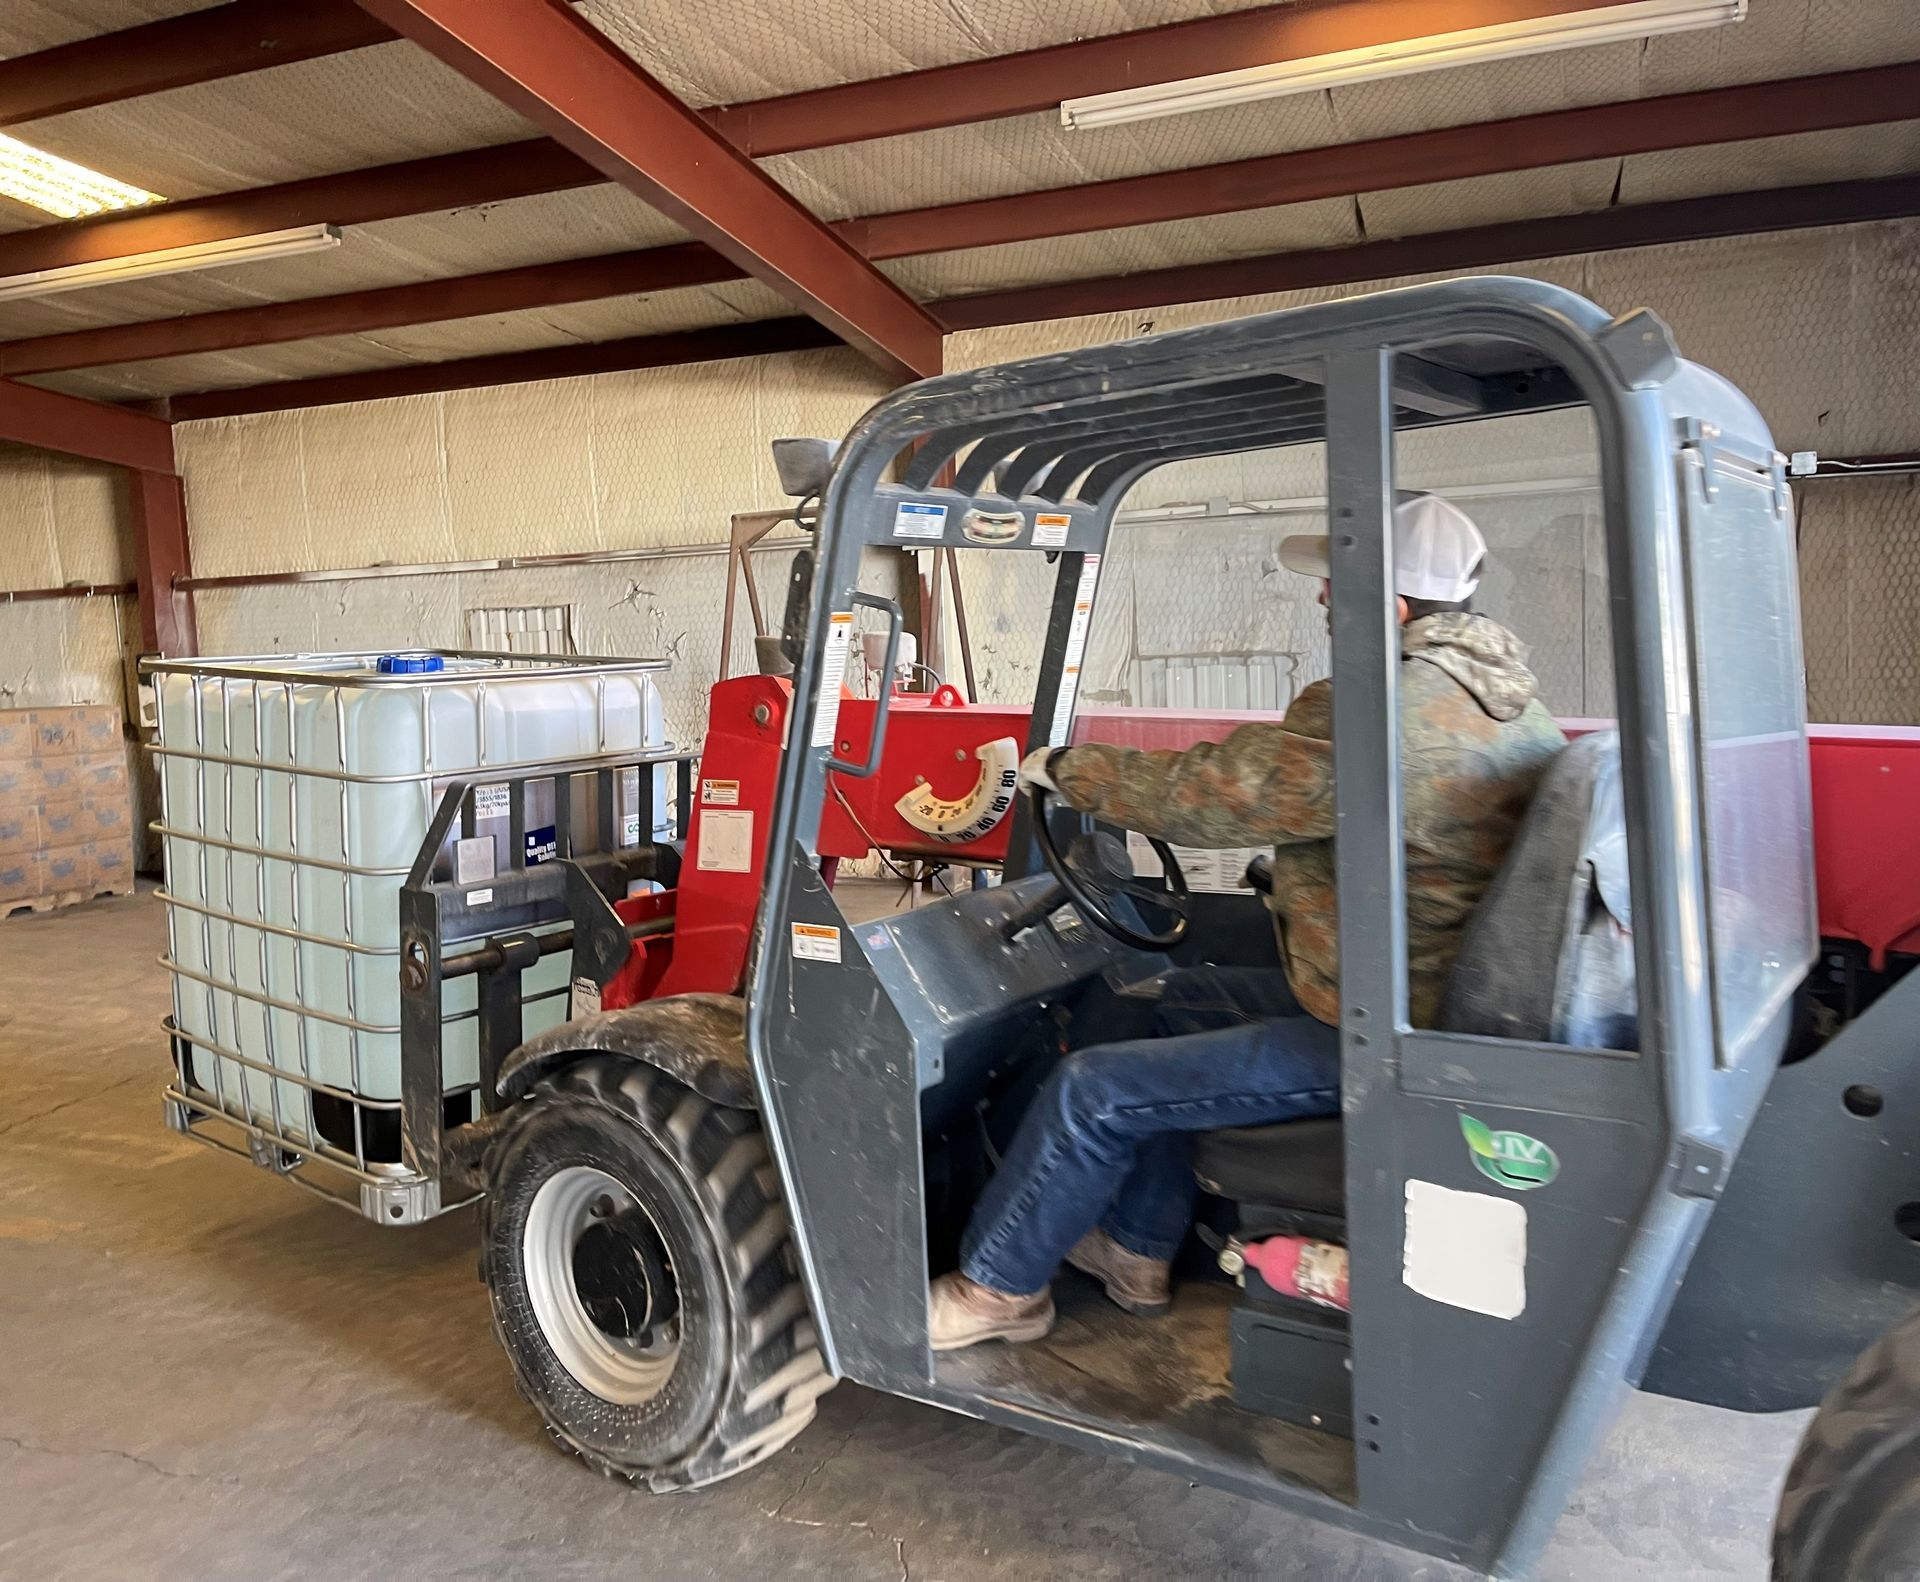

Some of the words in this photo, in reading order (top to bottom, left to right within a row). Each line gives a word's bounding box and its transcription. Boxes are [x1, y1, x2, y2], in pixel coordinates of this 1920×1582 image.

[977, 818, 996, 831] 40
[991, 796, 1010, 813] 60
[1001, 769, 1016, 788] 80
[526, 845, 547, 858] Quality
